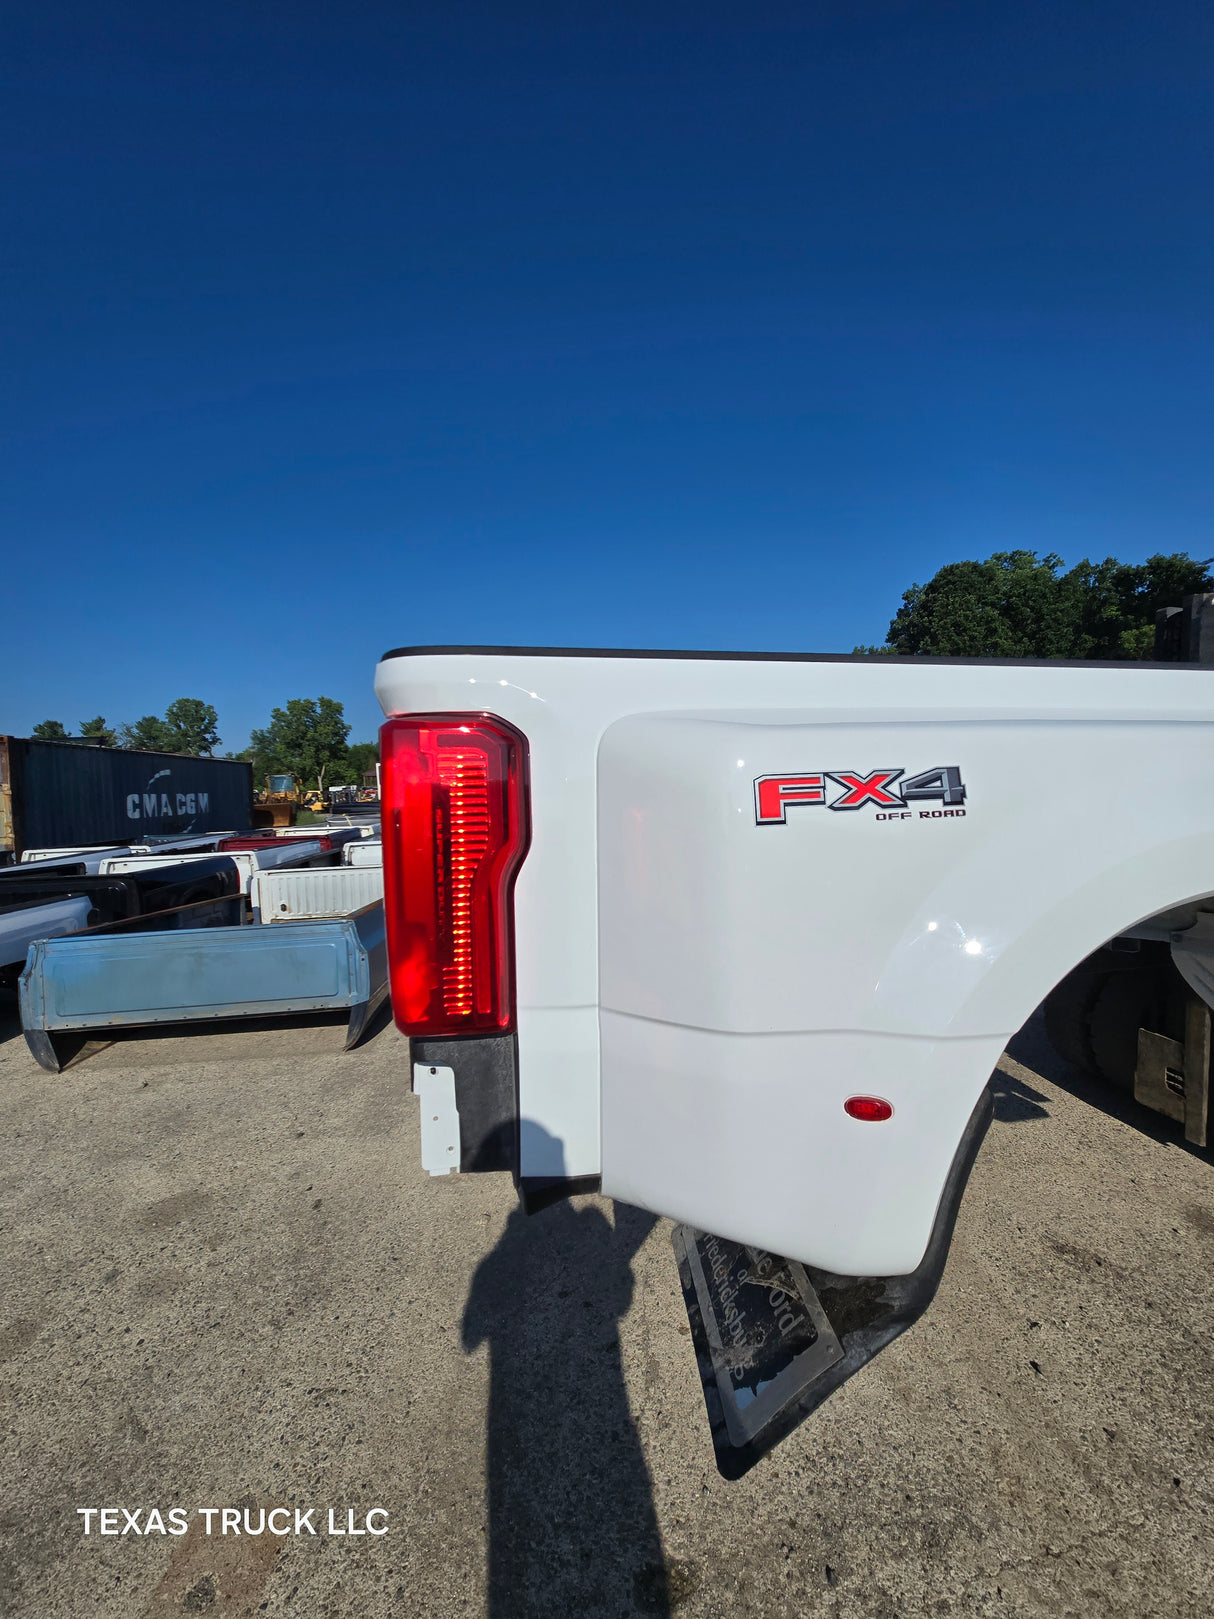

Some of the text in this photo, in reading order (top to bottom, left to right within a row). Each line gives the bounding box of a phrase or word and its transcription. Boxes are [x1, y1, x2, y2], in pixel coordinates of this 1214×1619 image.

[126, 793, 209, 819] CMA CGM
[753, 766, 966, 825] FX4
[875, 809, 967, 821] OFF ROAD
